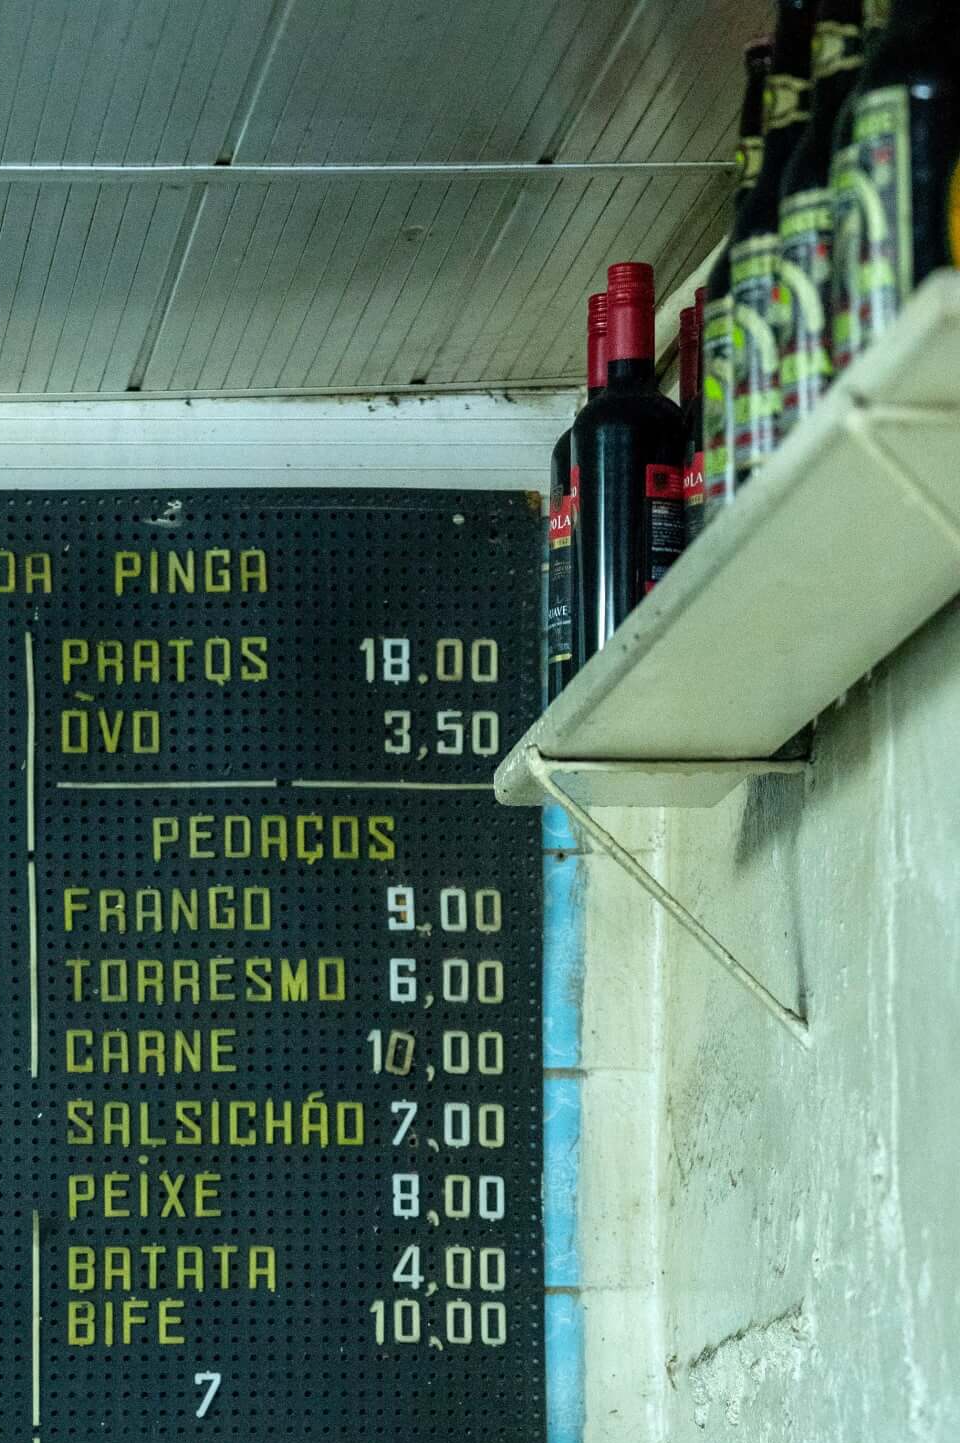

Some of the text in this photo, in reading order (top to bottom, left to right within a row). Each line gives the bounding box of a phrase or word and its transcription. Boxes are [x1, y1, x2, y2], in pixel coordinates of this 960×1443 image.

[115, 547, 266, 596] PINGA
[360, 638, 497, 685] 18.00
[385, 709, 498, 760] 3,50
[153, 812, 394, 864] PEDAÇOS
[64, 884, 270, 933] FRANGO
[66, 956, 503, 1008] TORRESMO 6,00
[67, 1028, 503, 1081] CARNE 10,00
[391, 1099, 504, 1152] 7,00
[392, 1174, 504, 1226] 8,00
[69, 1243, 505, 1296] BATATA 4,00
[69, 1297, 506, 1350] BIFE 10,00
[195, 1371, 221, 1418] 7
